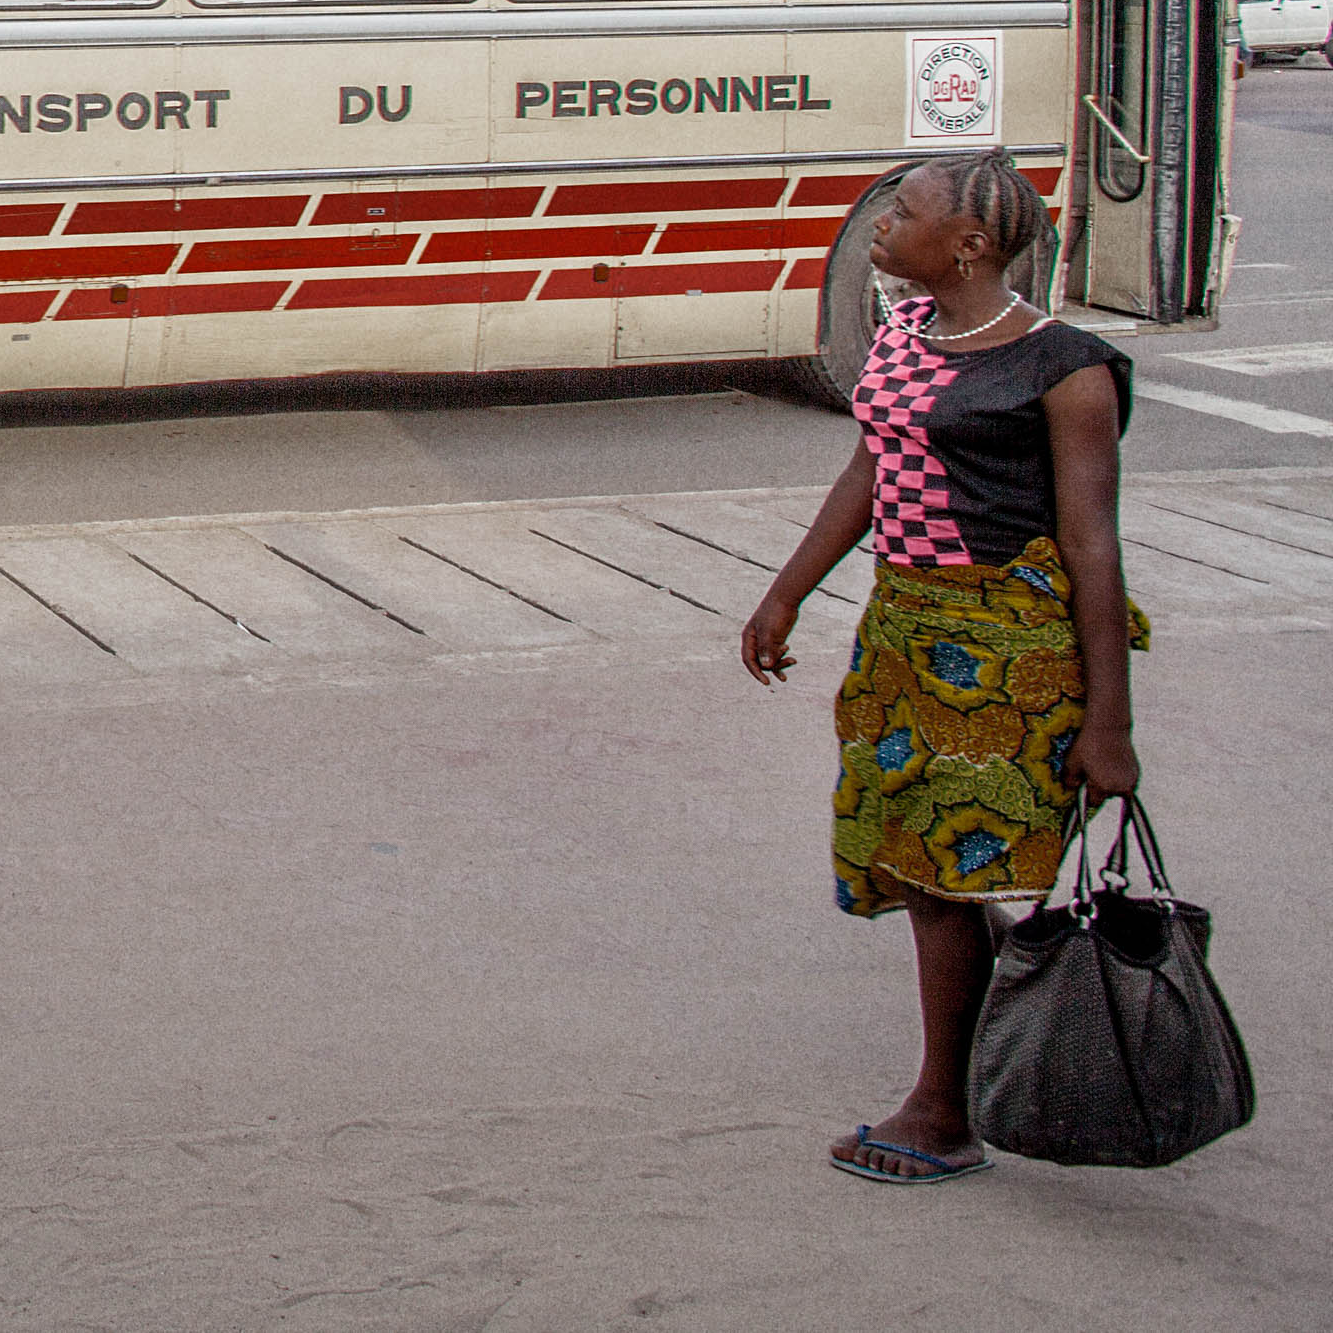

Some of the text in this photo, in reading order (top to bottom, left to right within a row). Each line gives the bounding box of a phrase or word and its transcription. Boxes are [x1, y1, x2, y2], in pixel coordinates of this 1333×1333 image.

[921, 46, 989, 82] DIRECTION
[338, 85, 413, 125] DU
[516, 74, 832, 119] PERSONNEL
[921, 99, 987, 130] GENERALE
